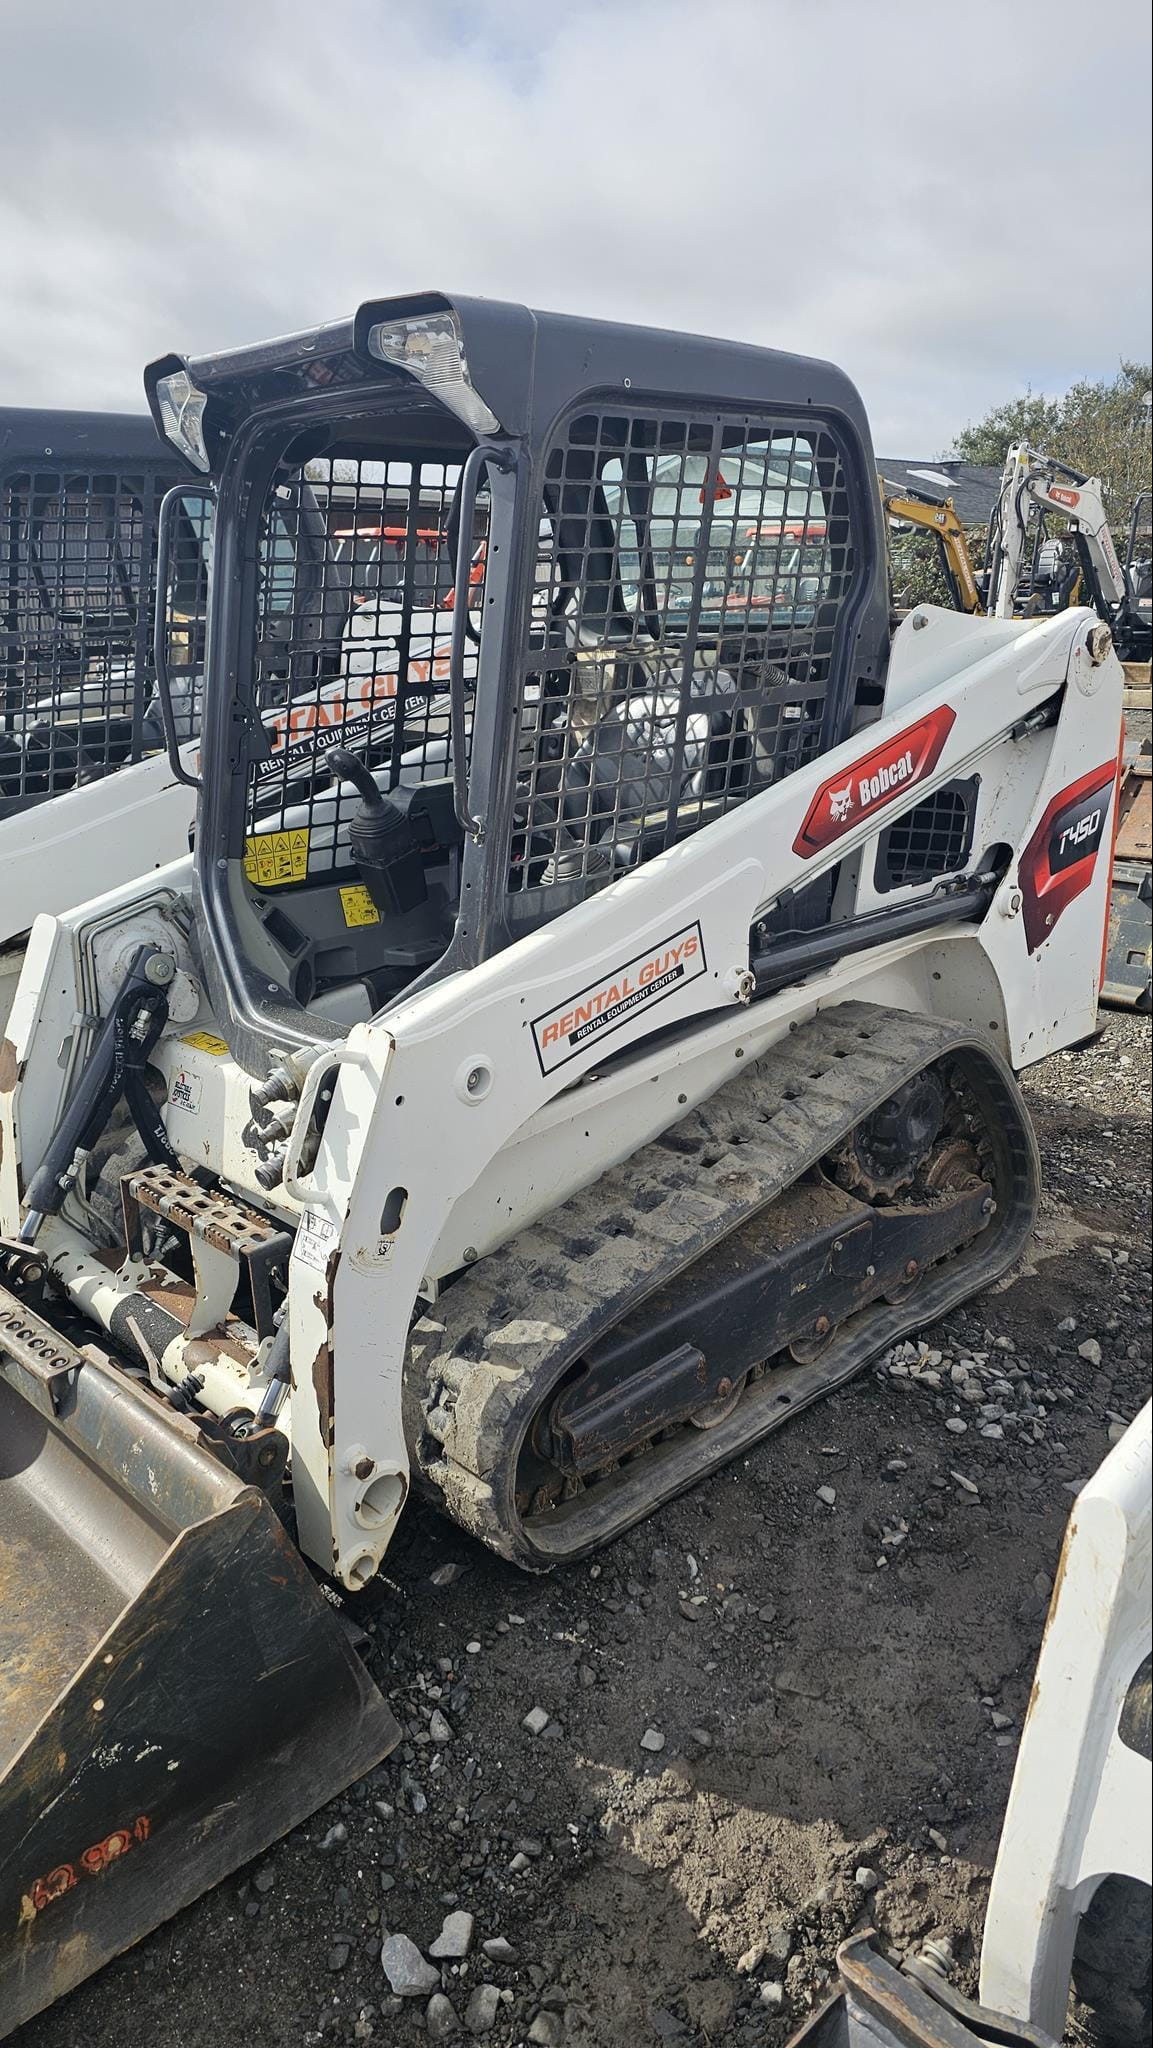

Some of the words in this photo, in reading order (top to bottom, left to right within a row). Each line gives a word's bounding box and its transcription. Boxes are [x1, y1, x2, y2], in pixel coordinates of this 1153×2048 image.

[859, 750, 913, 807] Bobcat
[1060, 809, 1101, 855] T450
[542, 977, 635, 1049] RENTAL
[639, 936, 698, 986] GUYS
[577, 1015, 607, 1039] RENTAL
[607, 990, 650, 1020] EQUIPMENT
[650, 971, 678, 992] CENTER
